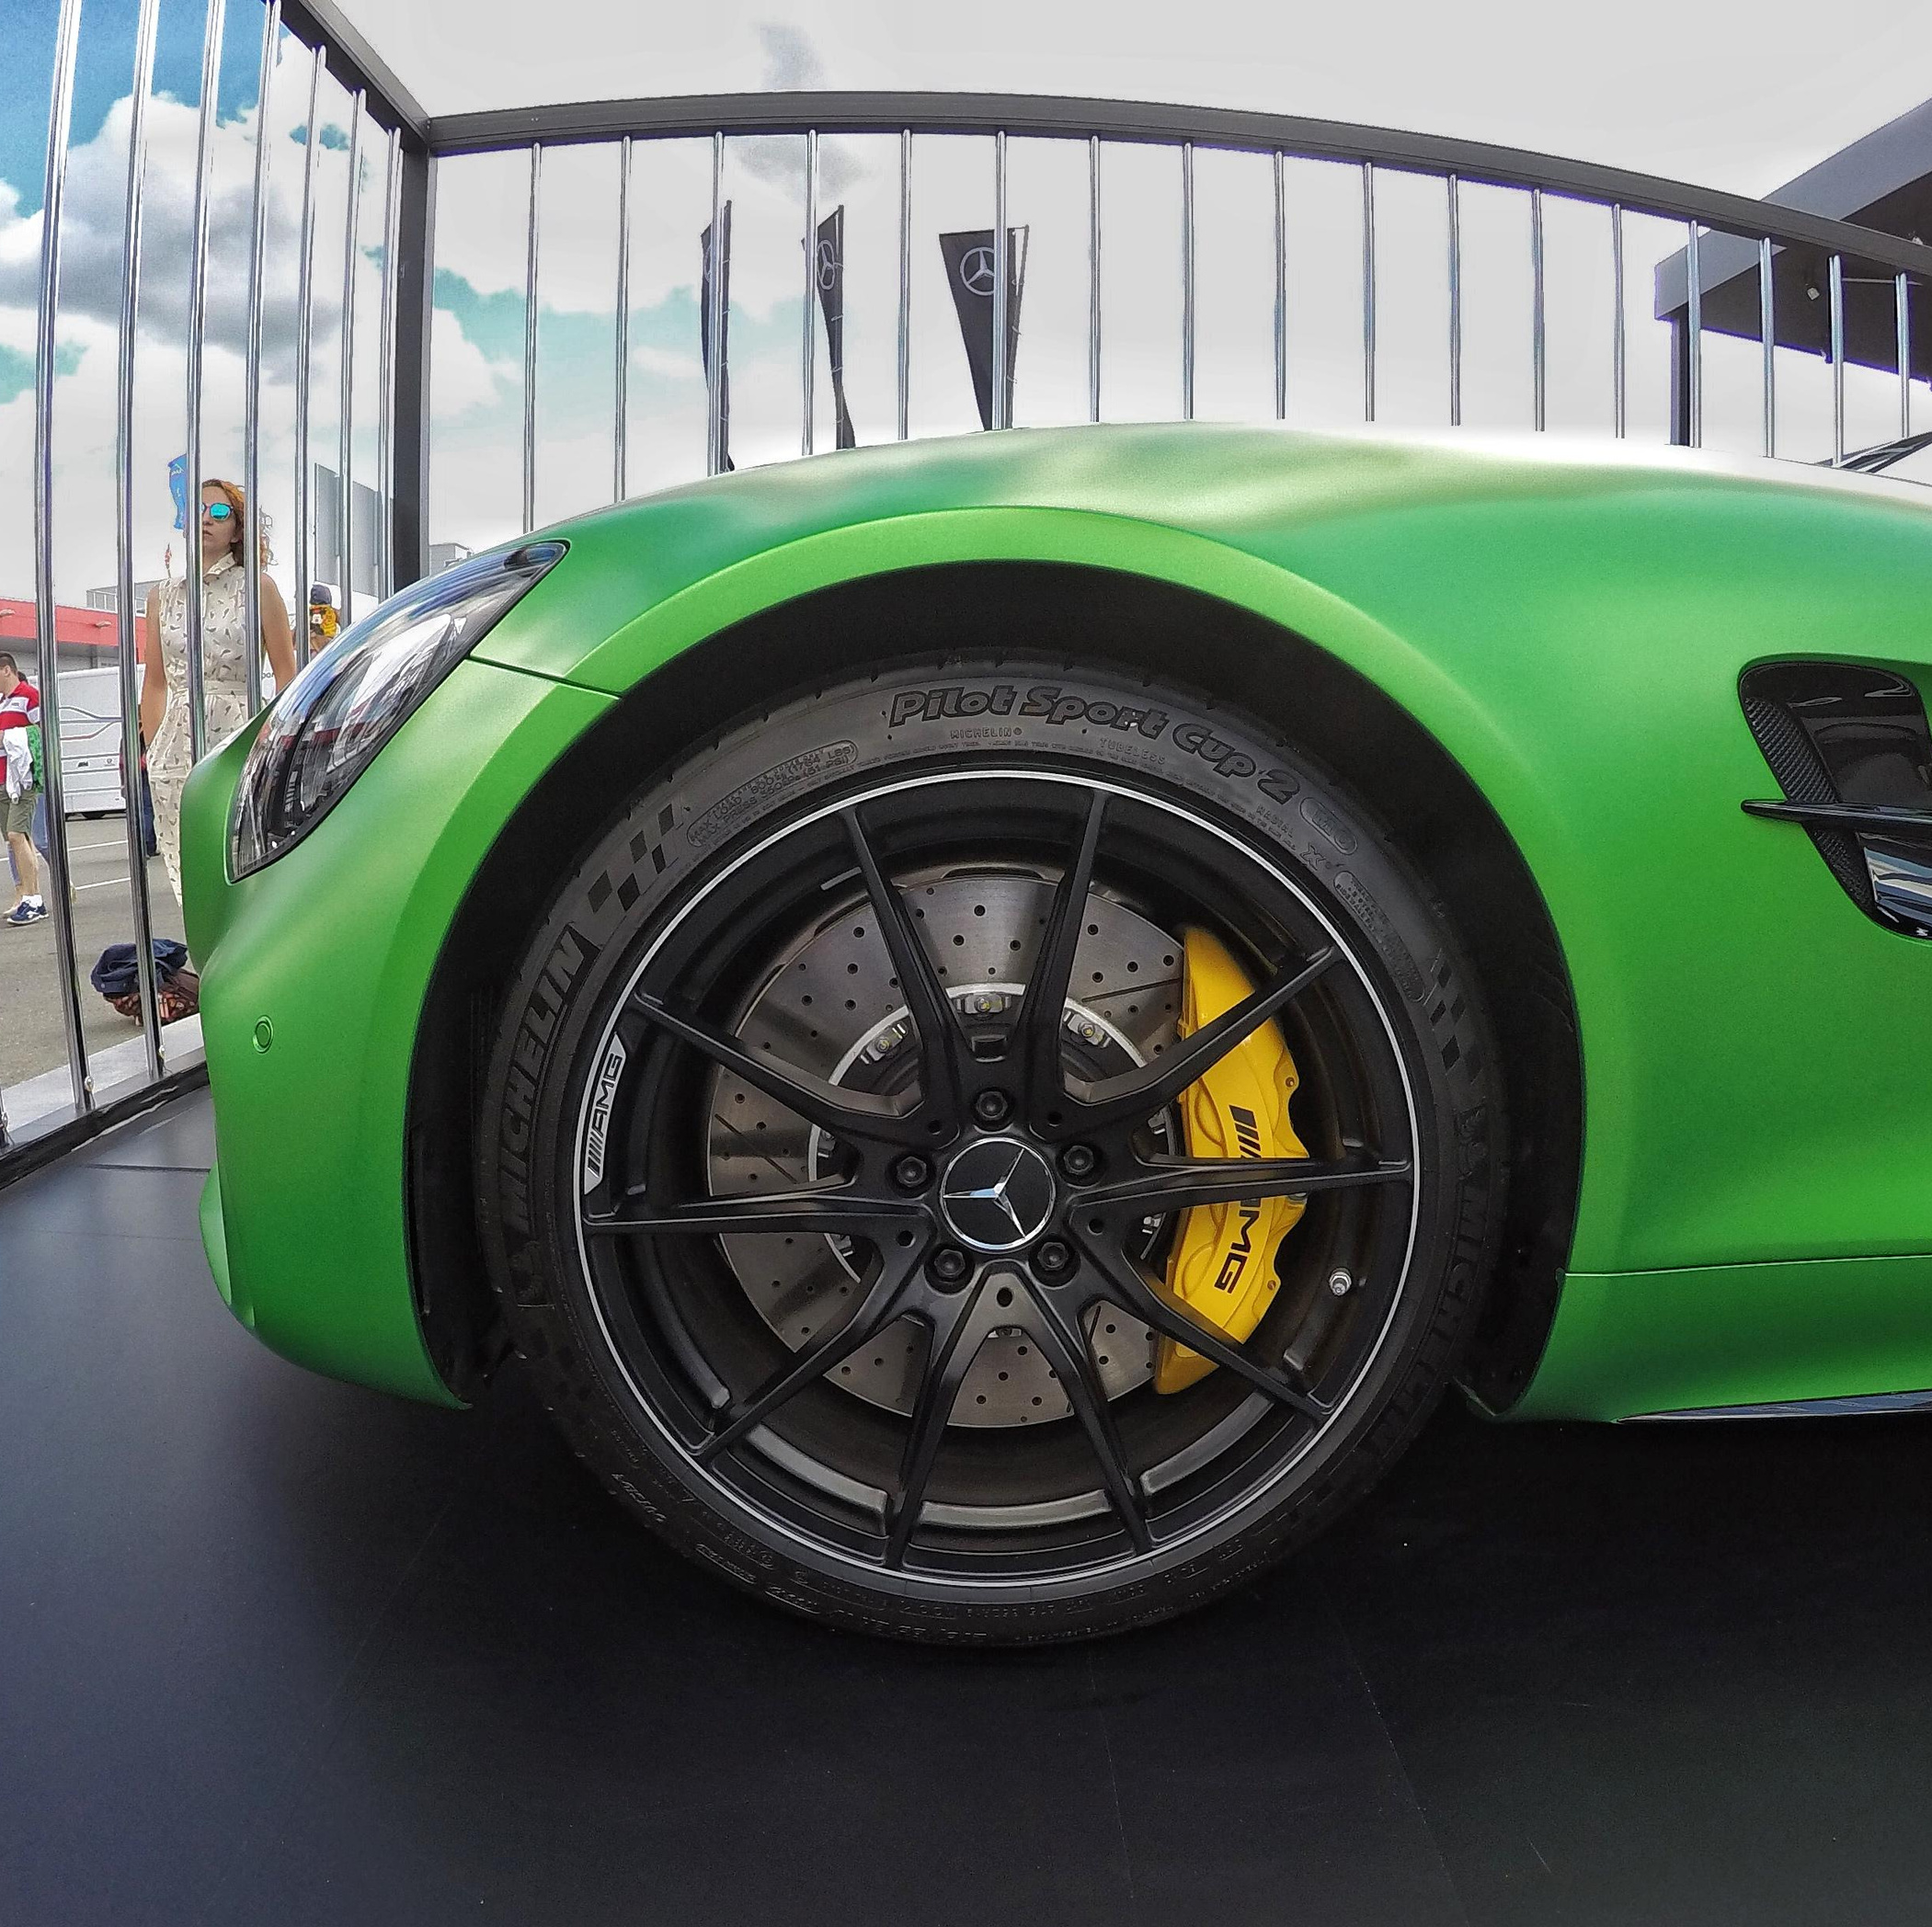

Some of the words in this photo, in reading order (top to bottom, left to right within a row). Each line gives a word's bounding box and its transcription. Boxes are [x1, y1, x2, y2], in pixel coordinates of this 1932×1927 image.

[714, 795, 742, 820] LOAD
[788, 755, 821, 776] (1764
[829, 745, 855, 759] LBS)
[889, 685, 1017, 727] Pilot
[1018, 685, 1171, 740] Sport
[1172, 723, 1257, 779] Cup
[1257, 769, 1300, 805] 2
[1100, 736, 1166, 765] TUBELESS
[723, 796, 757, 824] PRESS
[497, 928, 585, 1235] MICHELIN
[592, 1054, 623, 1138] AMG
